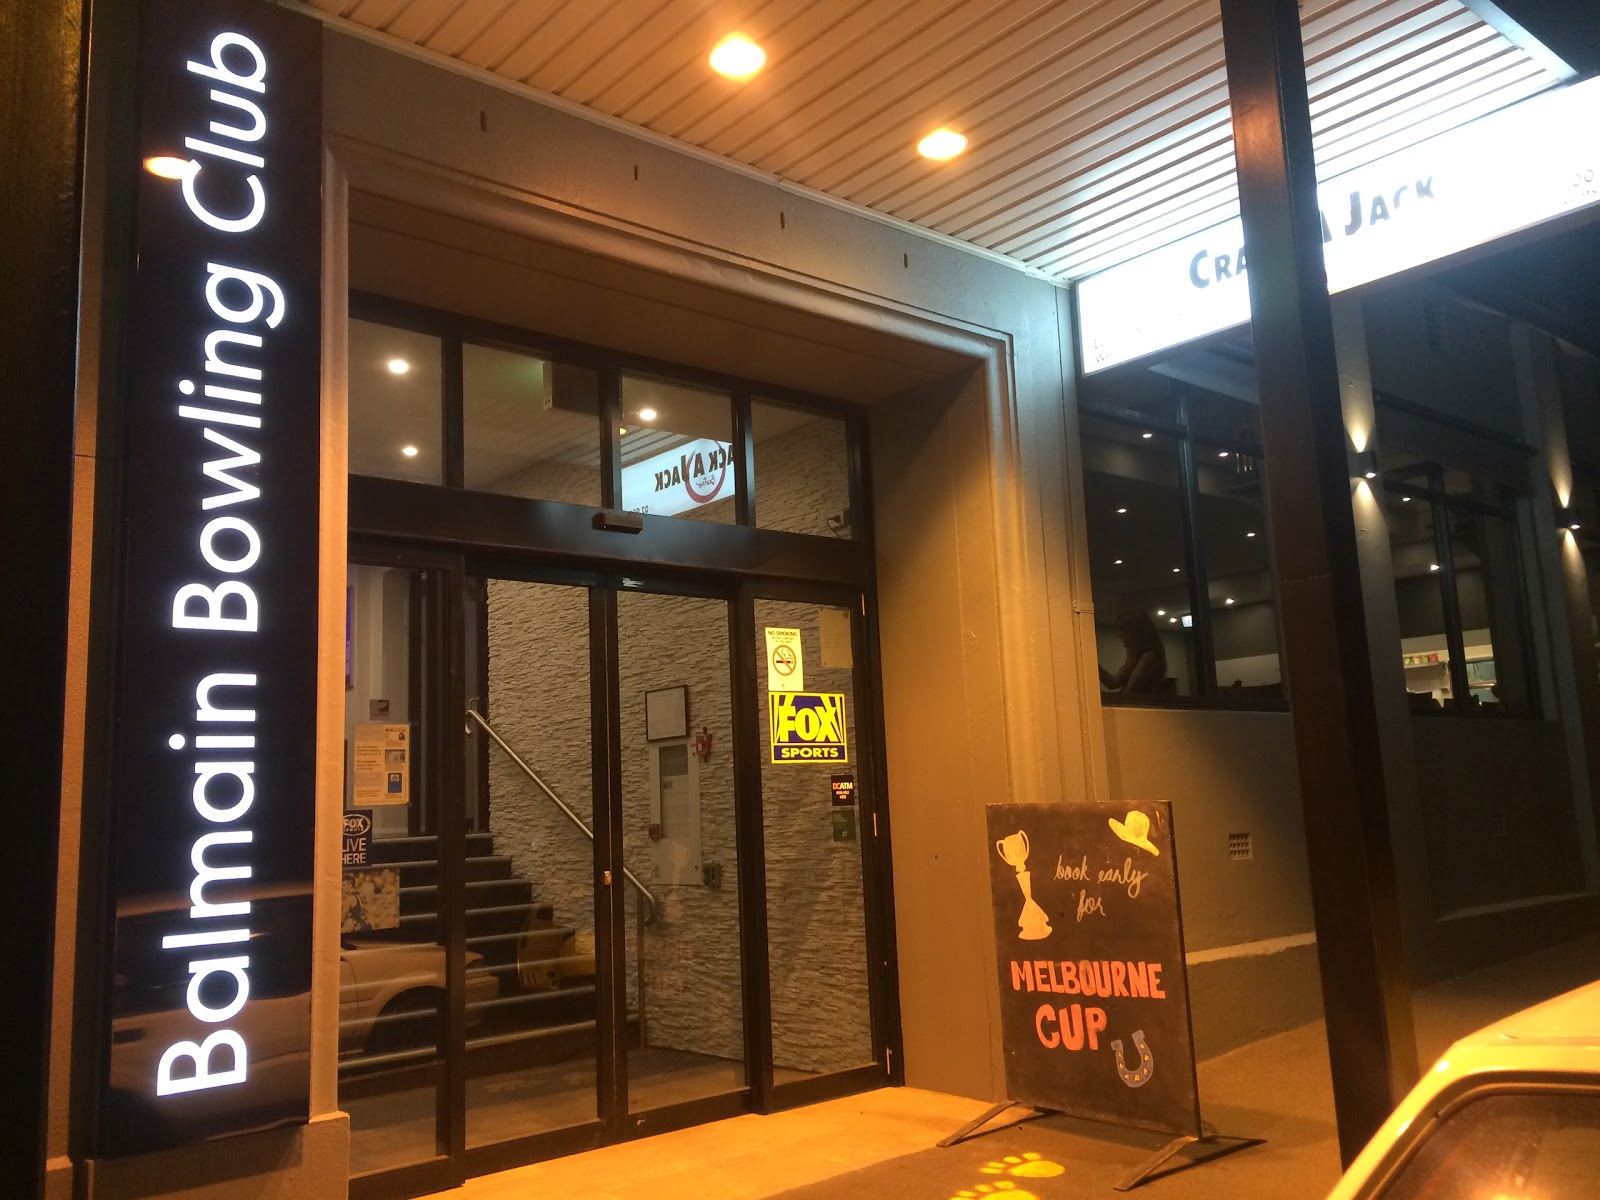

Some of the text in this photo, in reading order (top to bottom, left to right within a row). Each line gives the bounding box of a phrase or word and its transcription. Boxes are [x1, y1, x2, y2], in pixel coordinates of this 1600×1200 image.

[1189, 246, 1247, 289] CRA
[156, 31, 286, 1096] Balmain Bowling Club
[777, 705, 839, 743] FOX
[781, 747, 839, 759] SPORTS
[343, 818, 364, 829] FOX
[1053, 855, 1149, 899] book early
[1076, 889, 1106, 922] for
[1010, 959, 1166, 999] MELBOURNE
[1035, 1003, 1108, 1051] CUP
